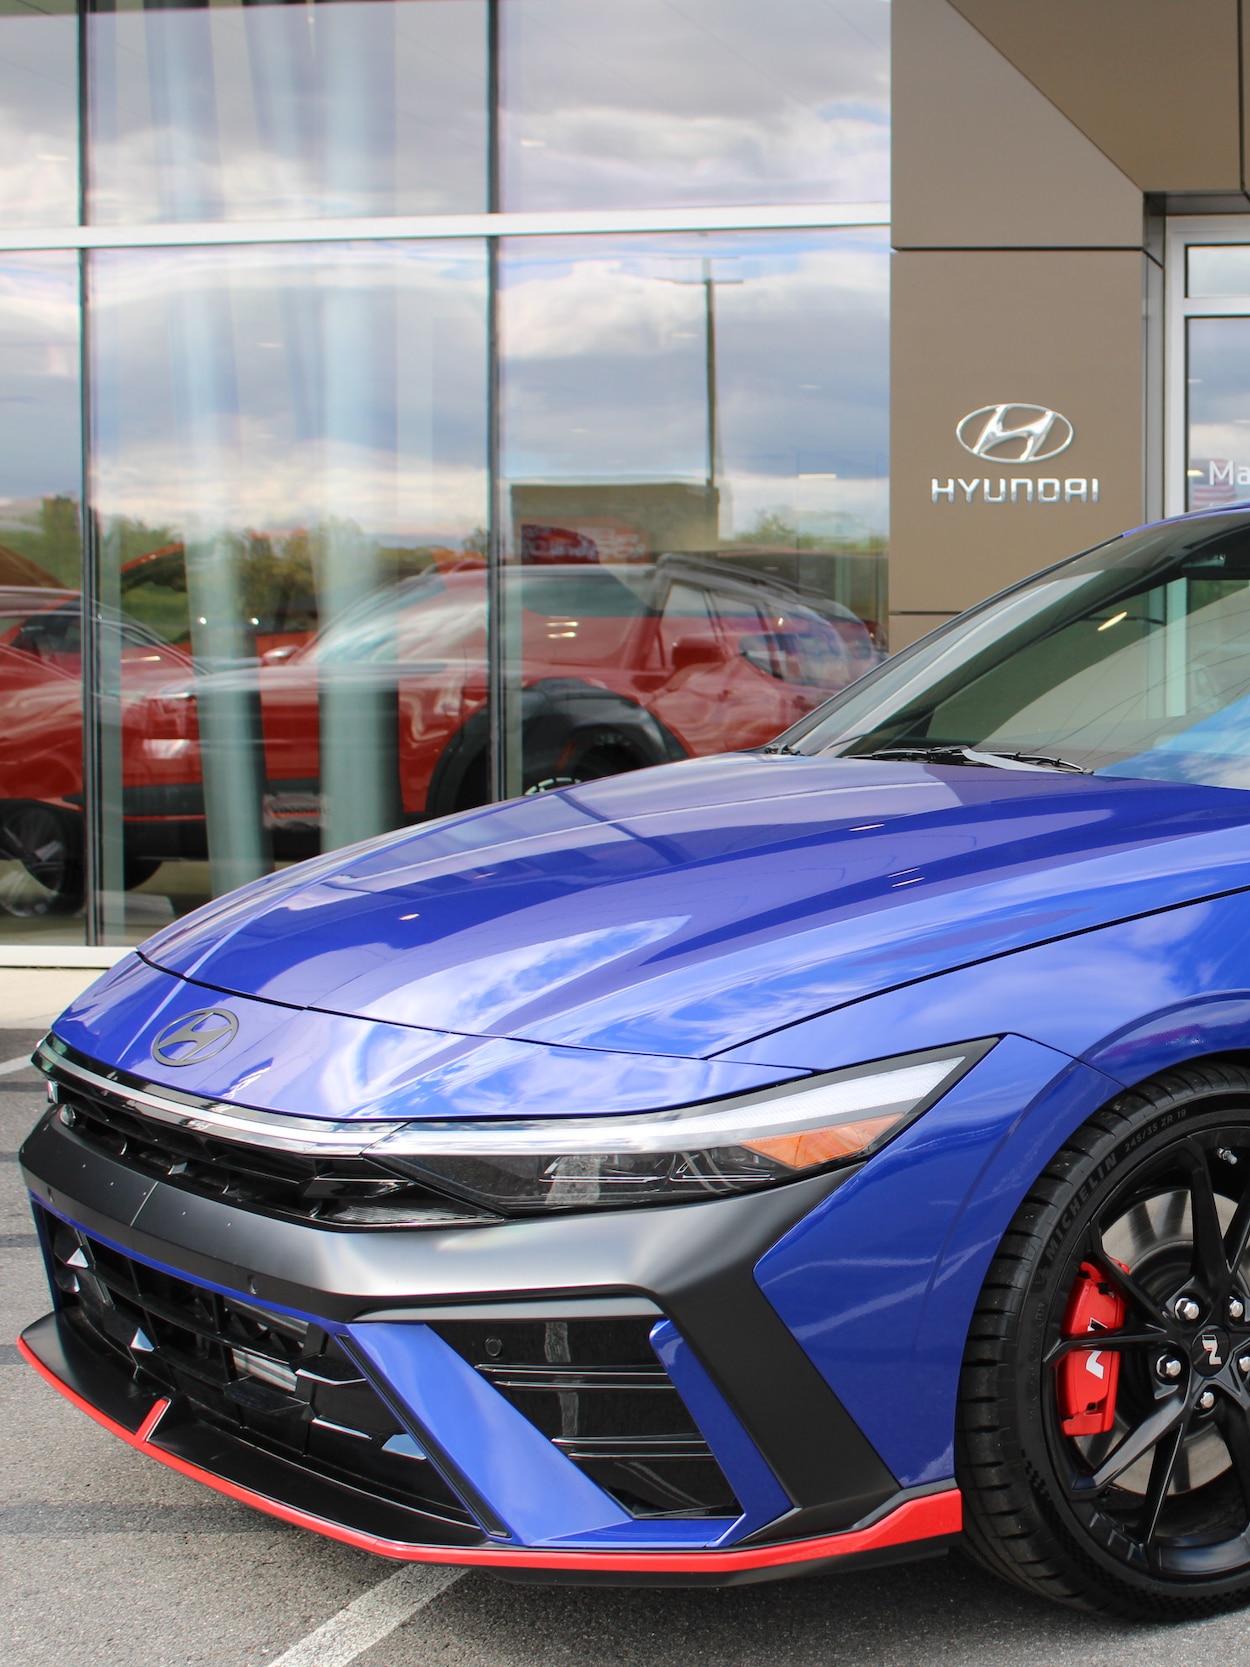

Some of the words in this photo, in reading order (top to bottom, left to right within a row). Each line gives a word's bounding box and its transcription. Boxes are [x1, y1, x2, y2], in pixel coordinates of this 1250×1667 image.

[931, 478, 1099, 503] HYUNDAI
[1044, 1152, 1118, 1261] MICHELIN
[1125, 1122, 1158, 1152] 245/35
[1161, 1114, 1174, 1126] ZR
[1177, 1109, 1187, 1118] 19
